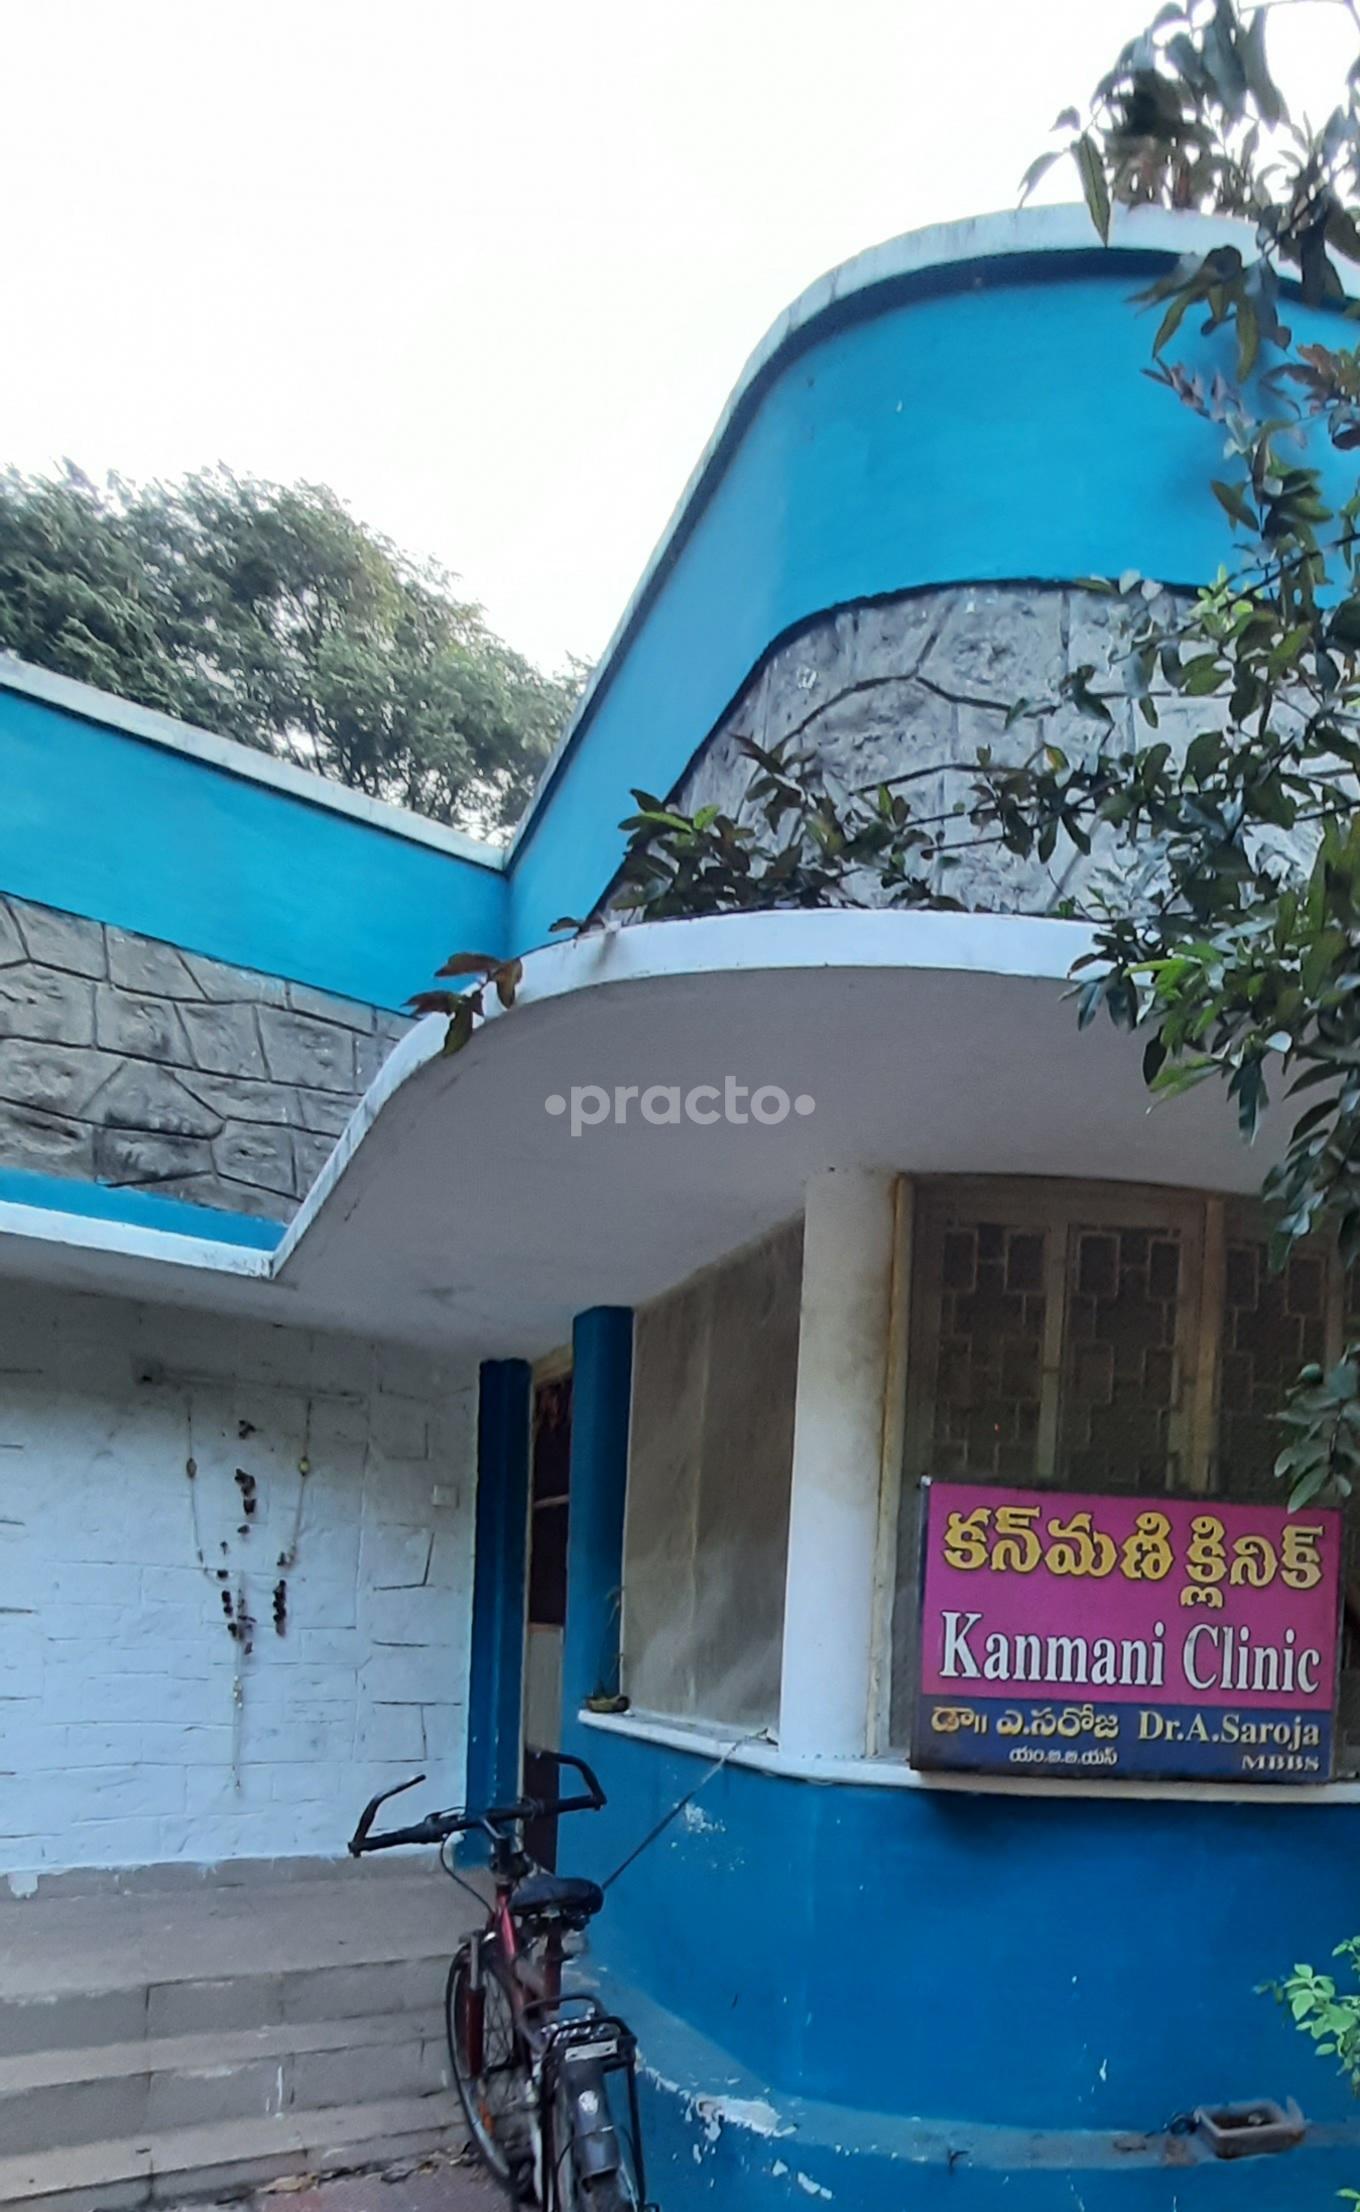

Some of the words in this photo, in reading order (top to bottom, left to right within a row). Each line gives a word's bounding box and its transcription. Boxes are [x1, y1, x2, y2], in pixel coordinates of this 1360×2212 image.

[1179, 1515, 1325, 1610] క్లినిక్
[938, 1610, 1167, 1687] Kanmani
[1181, 1621, 1321, 1694] Clinic
[1137, 1709, 1321, 1752] Dr.A.Saroja
[1240, 1753, 1321, 1772] MBBS
